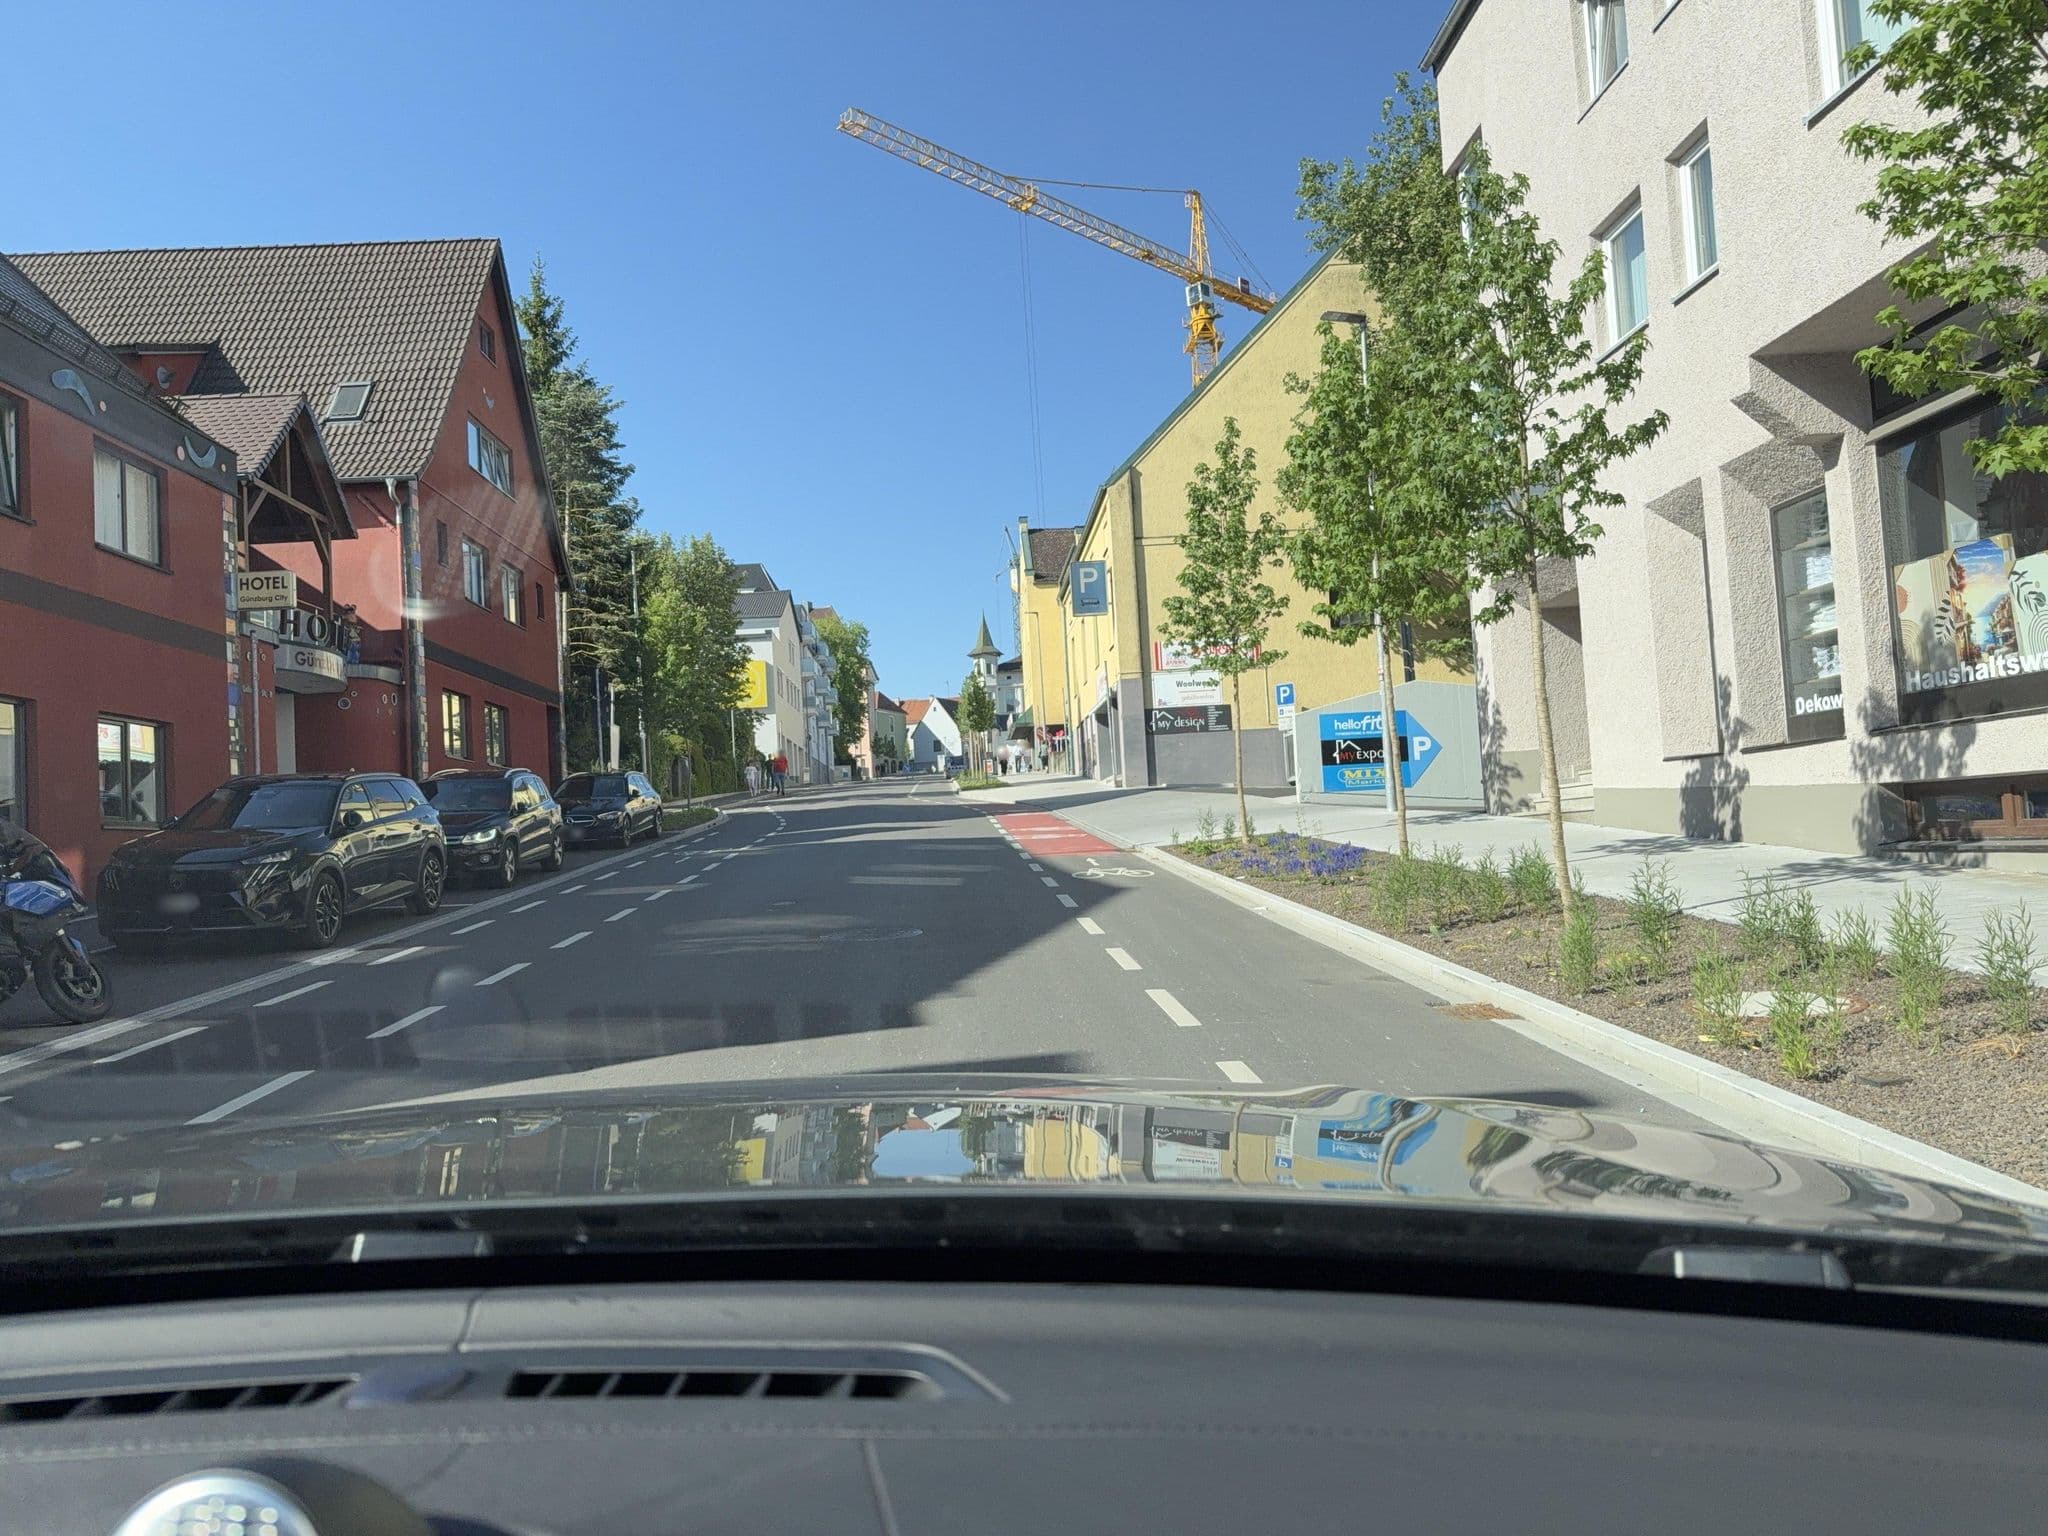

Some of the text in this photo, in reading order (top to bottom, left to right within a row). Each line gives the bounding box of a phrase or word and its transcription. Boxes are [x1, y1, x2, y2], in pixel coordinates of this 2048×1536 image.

[240, 576, 288, 591] HOTEL
[1080, 567, 1098, 593] P
[240, 594, 288, 603] Günzburg City
[1280, 686, 1290, 703] P
[1413, 736, 1431, 760] P
